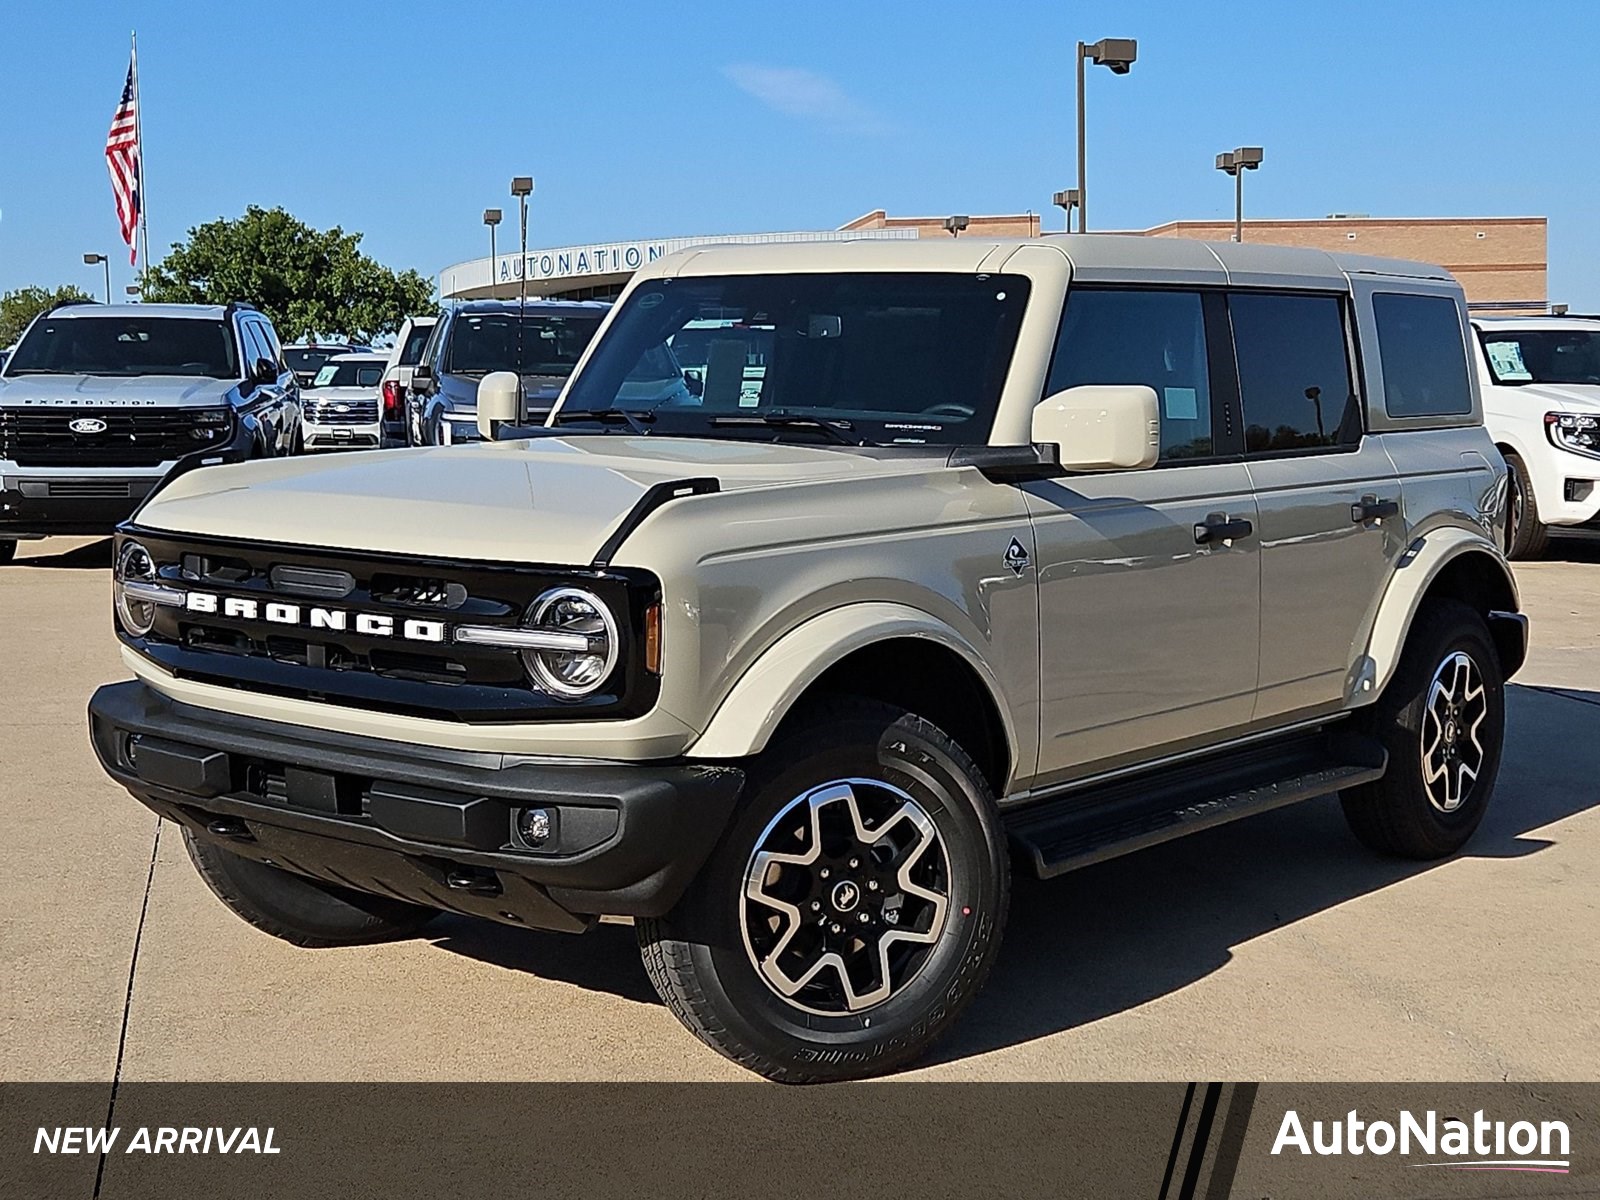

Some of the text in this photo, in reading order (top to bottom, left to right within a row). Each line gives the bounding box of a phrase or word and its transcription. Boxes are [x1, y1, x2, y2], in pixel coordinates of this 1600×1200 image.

[500, 244, 665, 281] AUTONATION
[74, 420, 102, 432] Ford
[186, 591, 447, 642] BRONCO
